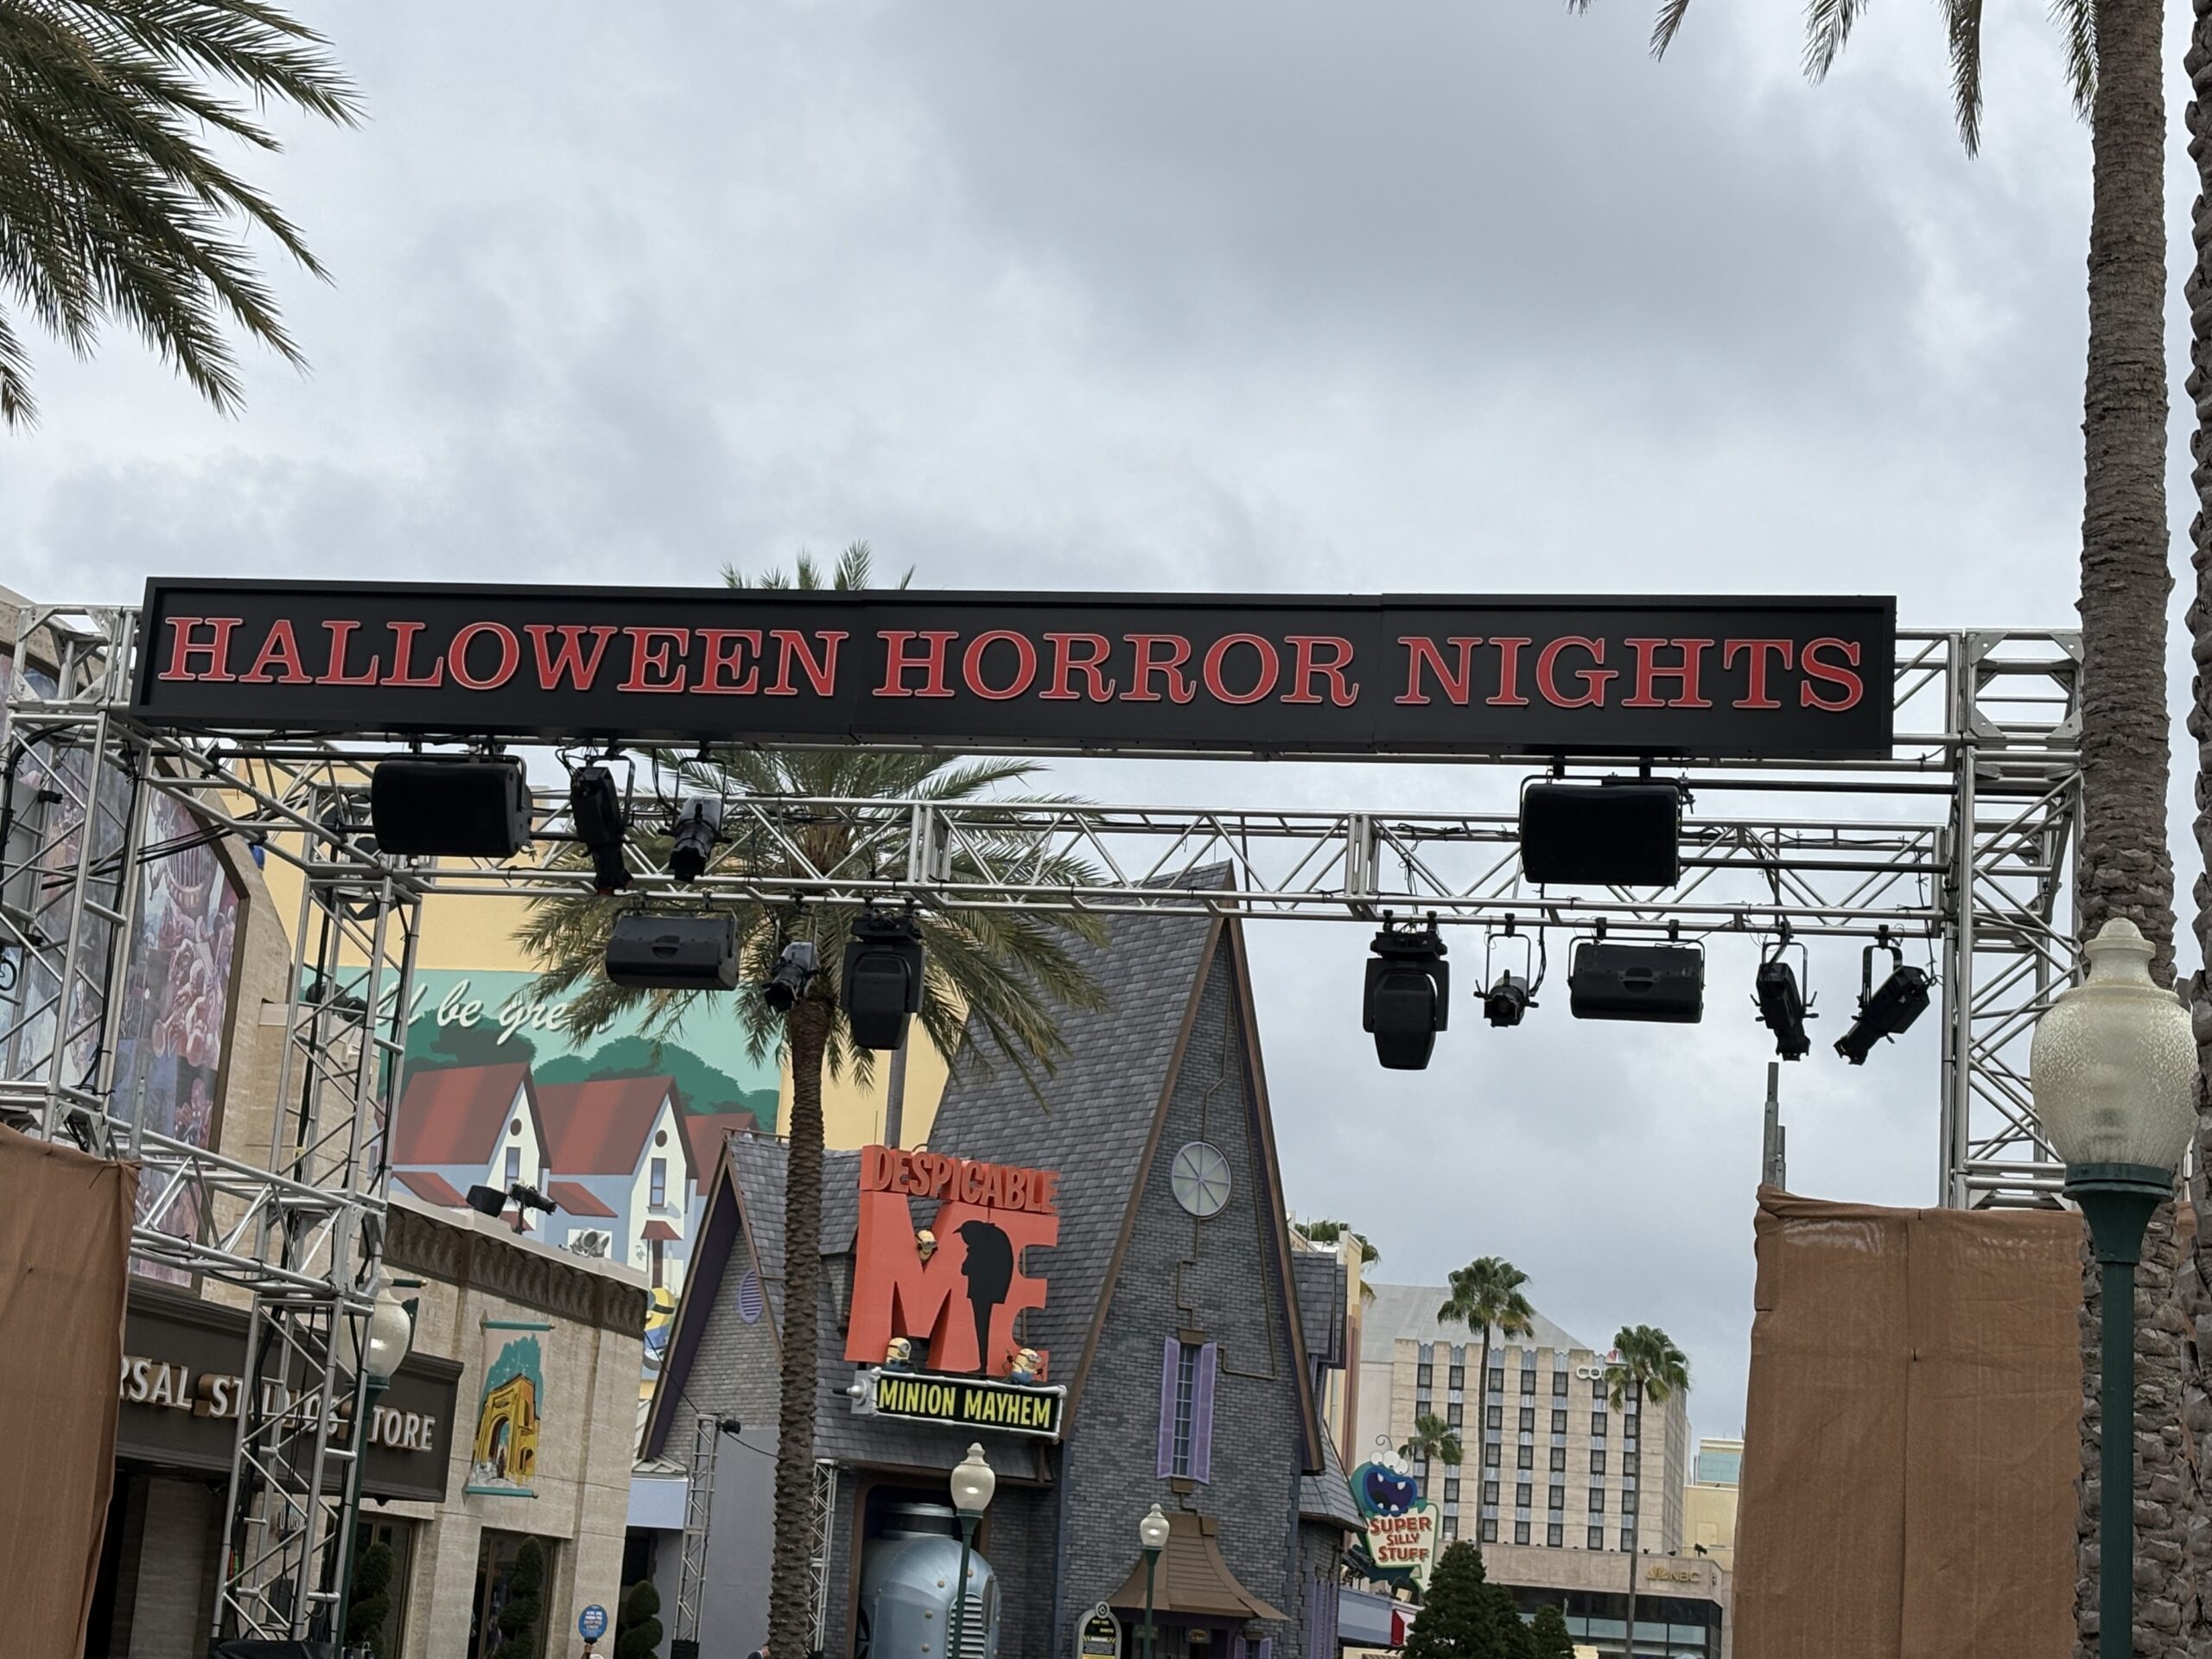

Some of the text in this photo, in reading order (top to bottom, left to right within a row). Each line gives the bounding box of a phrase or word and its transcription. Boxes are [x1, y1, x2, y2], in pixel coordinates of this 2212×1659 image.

[158, 616, 1865, 713] HALLOWEEN HORROR NIGHTS
[436, 978, 484, 1028] be
[871, 1144, 1060, 1214] DESPICABLE
[844, 1190, 1060, 1382] ME
[368, 1404, 435, 1452] TORE
[878, 1378, 1052, 1429] MINION MAYHEM
[1370, 1516, 1433, 1536] SUPER
[1386, 1532, 1421, 1547] SILLY
[1378, 1545, 1430, 1563] STUFF
[1669, 1571, 1701, 1584] NBC
